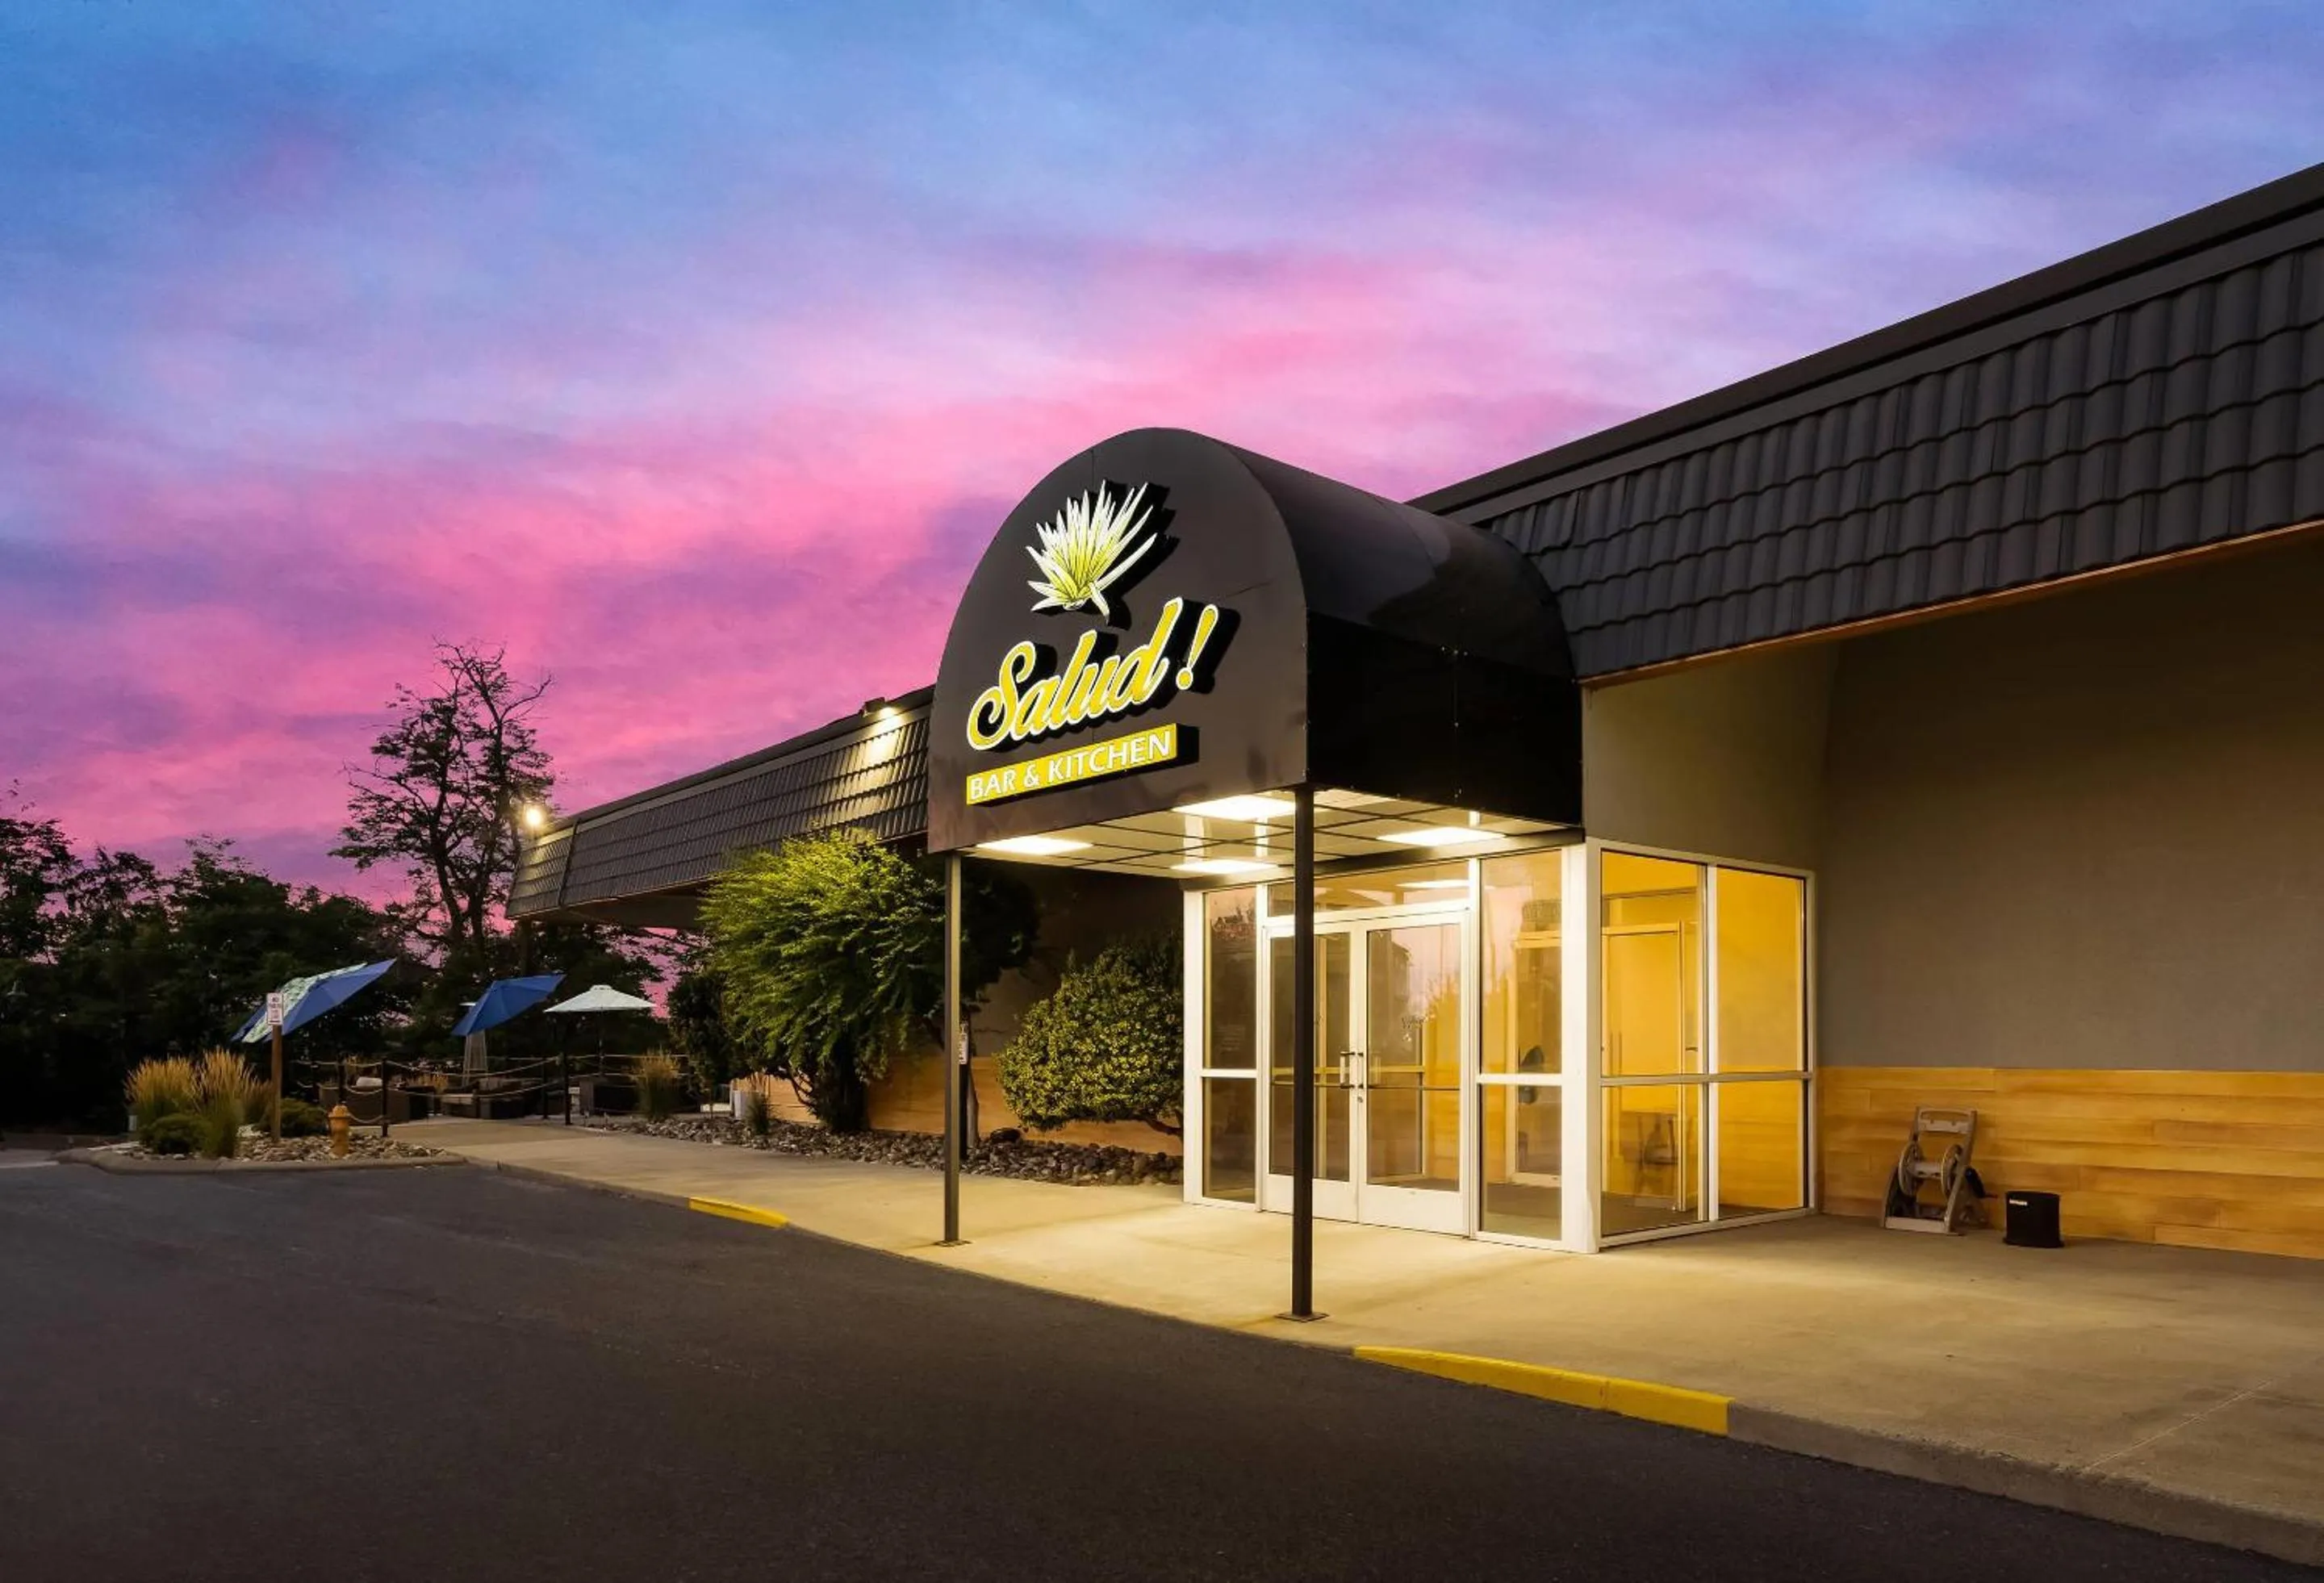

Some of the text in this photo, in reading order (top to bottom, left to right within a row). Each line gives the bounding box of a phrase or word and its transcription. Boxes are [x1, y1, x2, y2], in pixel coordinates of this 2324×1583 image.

[970, 730, 1171, 800] BAR & KITCHEN
